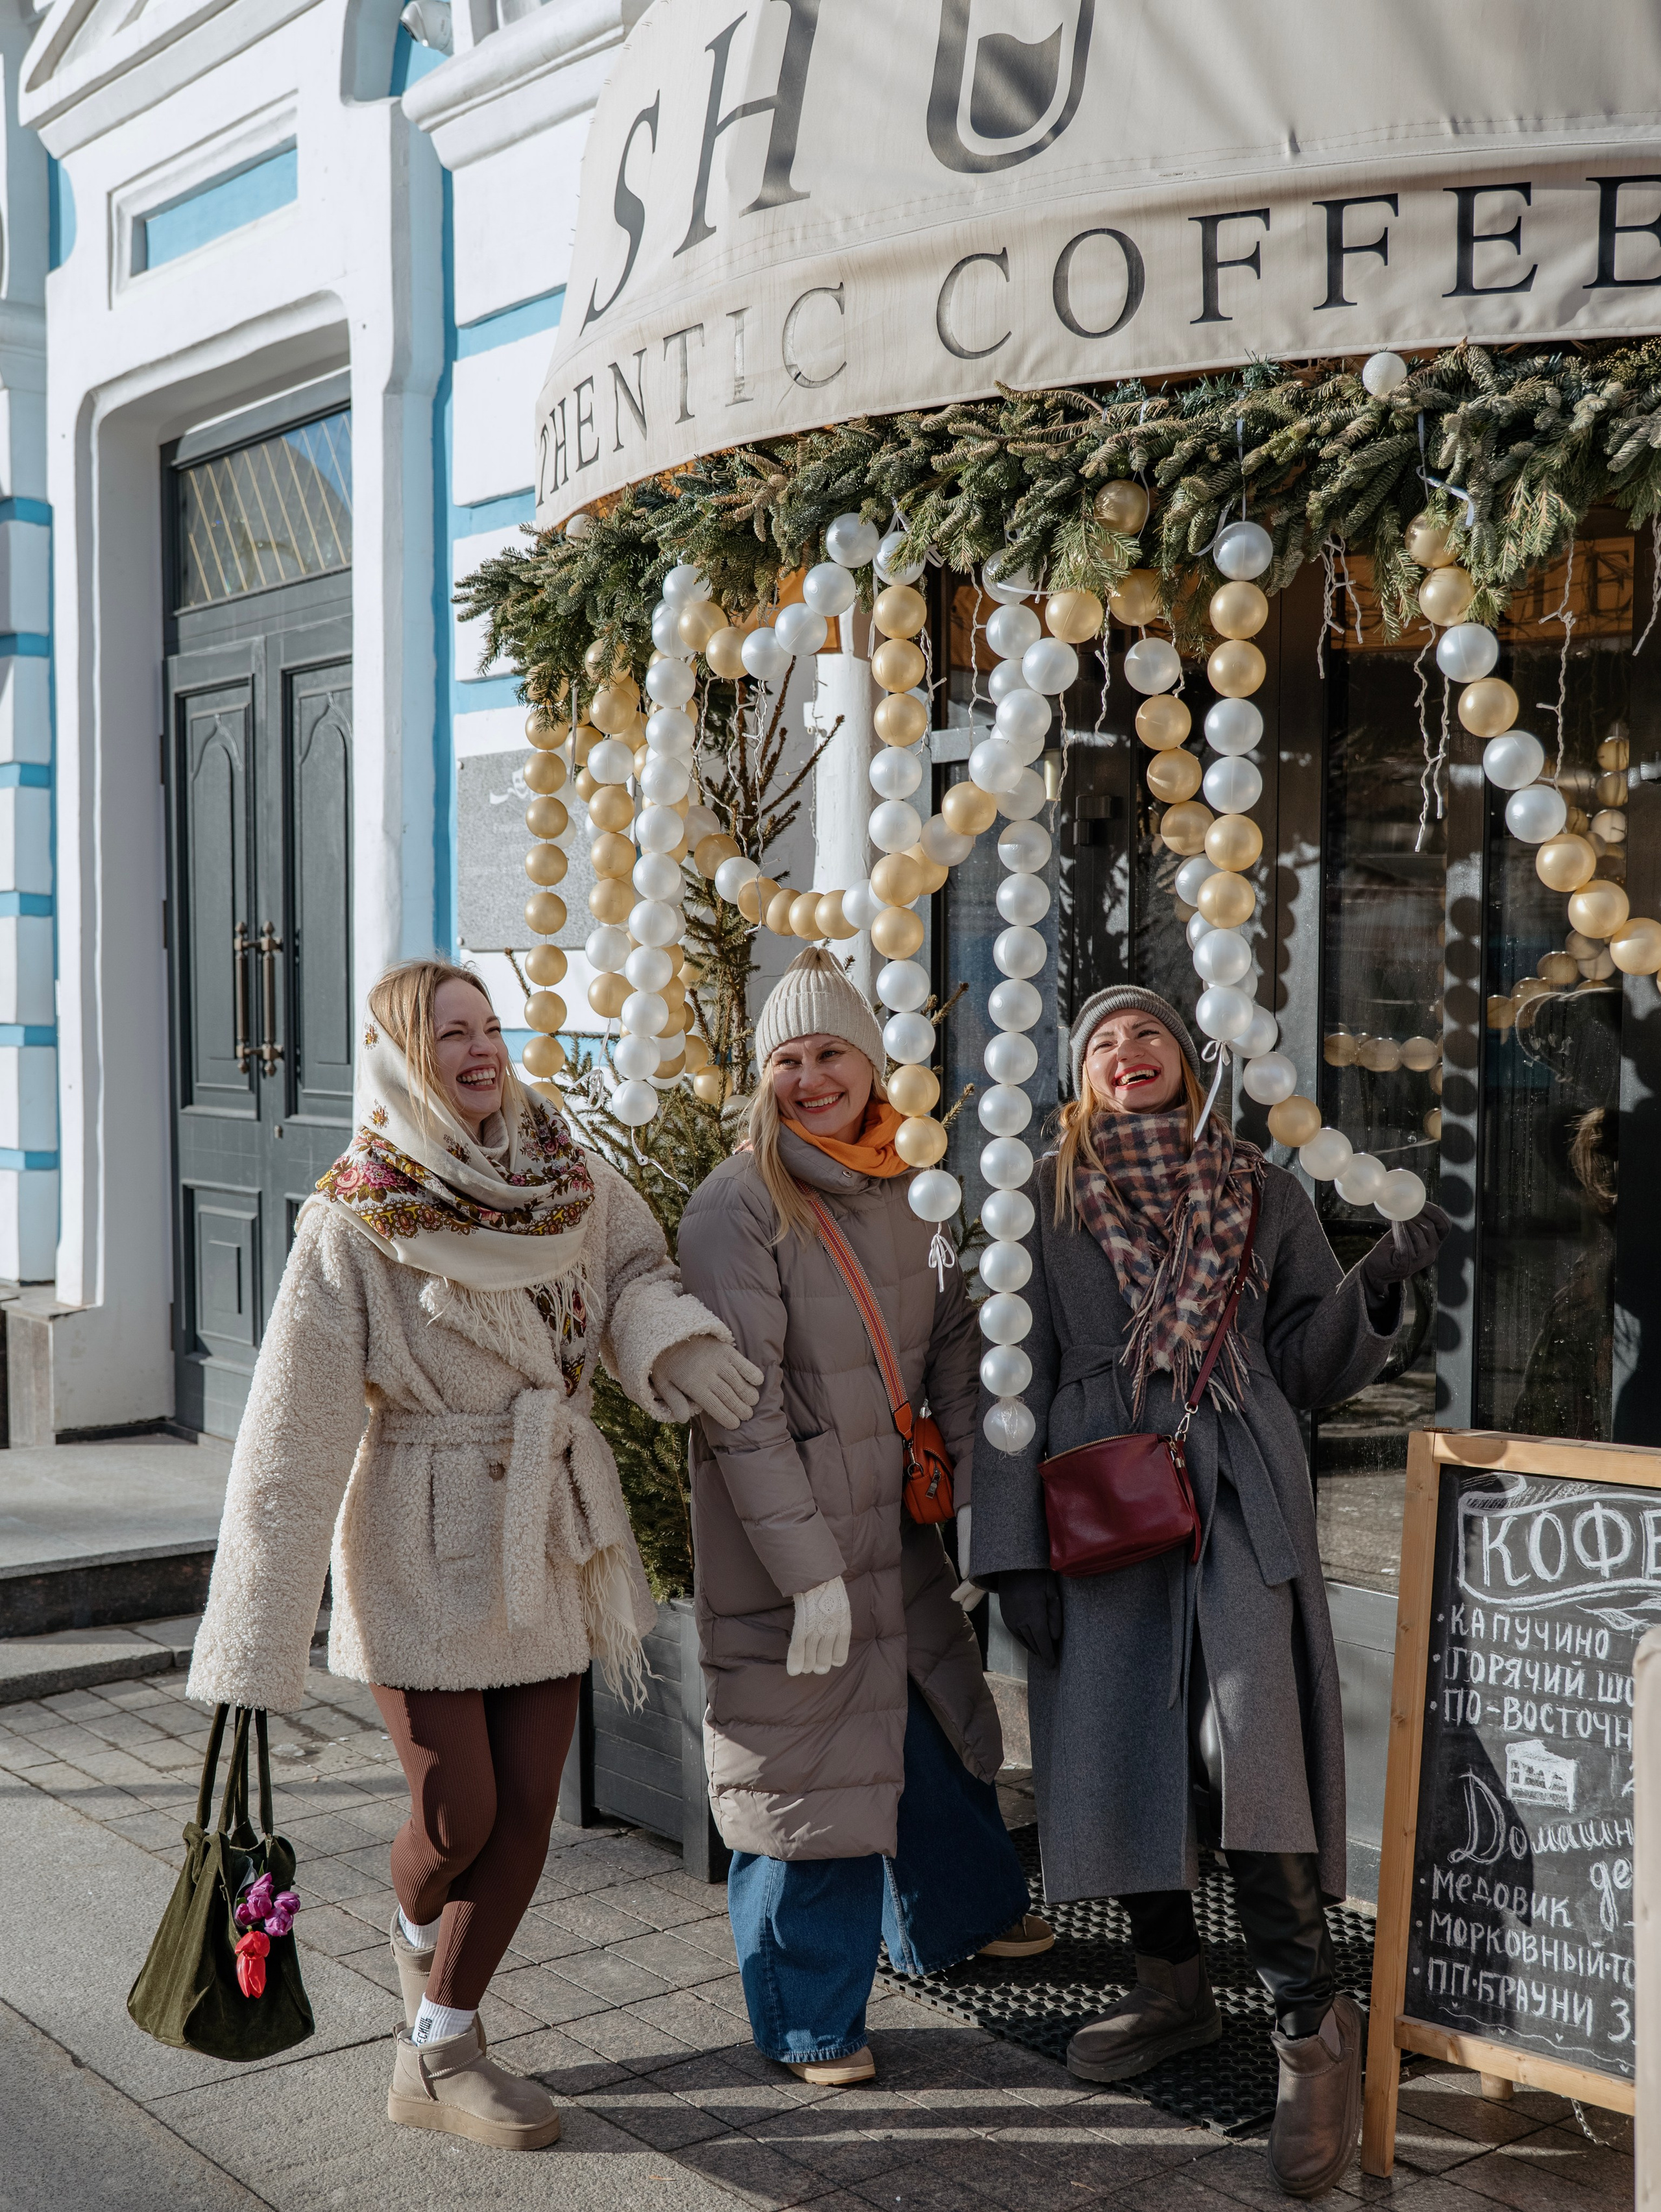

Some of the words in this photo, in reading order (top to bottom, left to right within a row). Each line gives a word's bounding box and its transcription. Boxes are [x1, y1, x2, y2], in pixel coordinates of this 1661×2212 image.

[936, 174, 1661, 361] COFFEE
[1482, 1501, 1661, 1587] КОФЕ
[1451, 1603, 1609, 1660] КАПУЧИНО
[1446, 1646, 1586, 1696] ГОРЯЧИЙ
